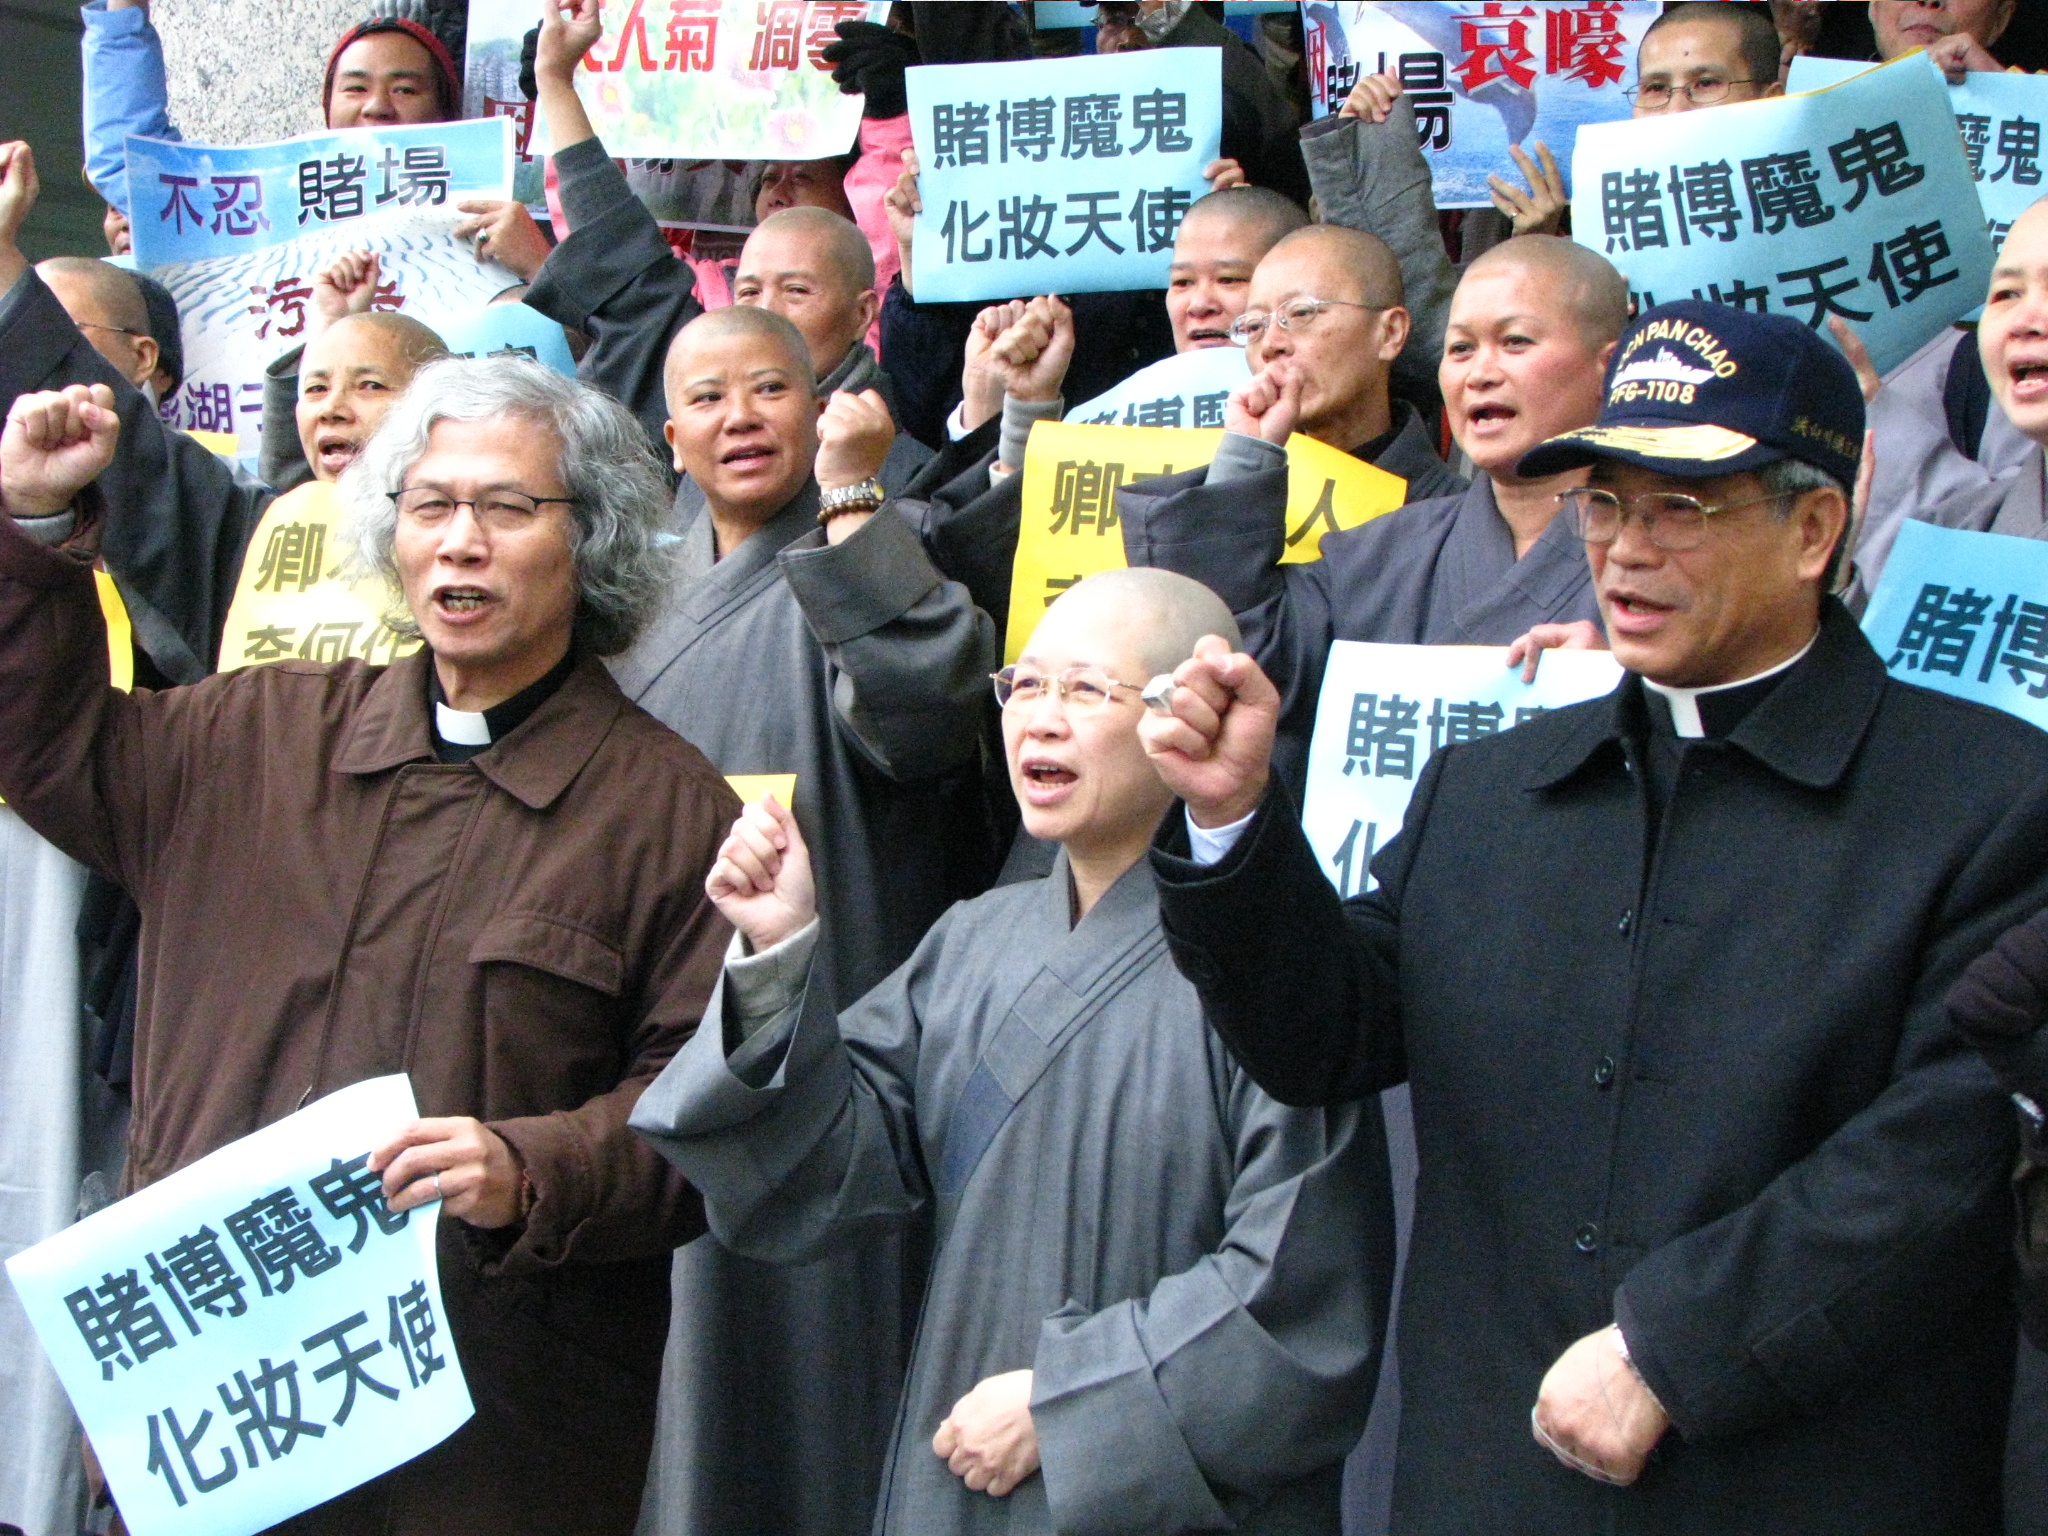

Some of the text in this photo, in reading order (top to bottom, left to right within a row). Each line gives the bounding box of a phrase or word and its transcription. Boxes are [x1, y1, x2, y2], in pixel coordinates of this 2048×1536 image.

[583, 0, 722, 72] 人菊
[933, 88, 1194, 170] 賭博魔鬼
[159, 145, 451, 236] 不忍 賭場
[940, 186, 1192, 264] 化妝天使
[1601, 121, 1925, 254] 賭博魔鬼
[1646, 319, 1690, 341] PAN
[1685, 327, 1737, 378] CHAO
[64, 1152, 410, 1381] 賭博魔鬼
[147, 1280, 446, 1508] 化妝天使
